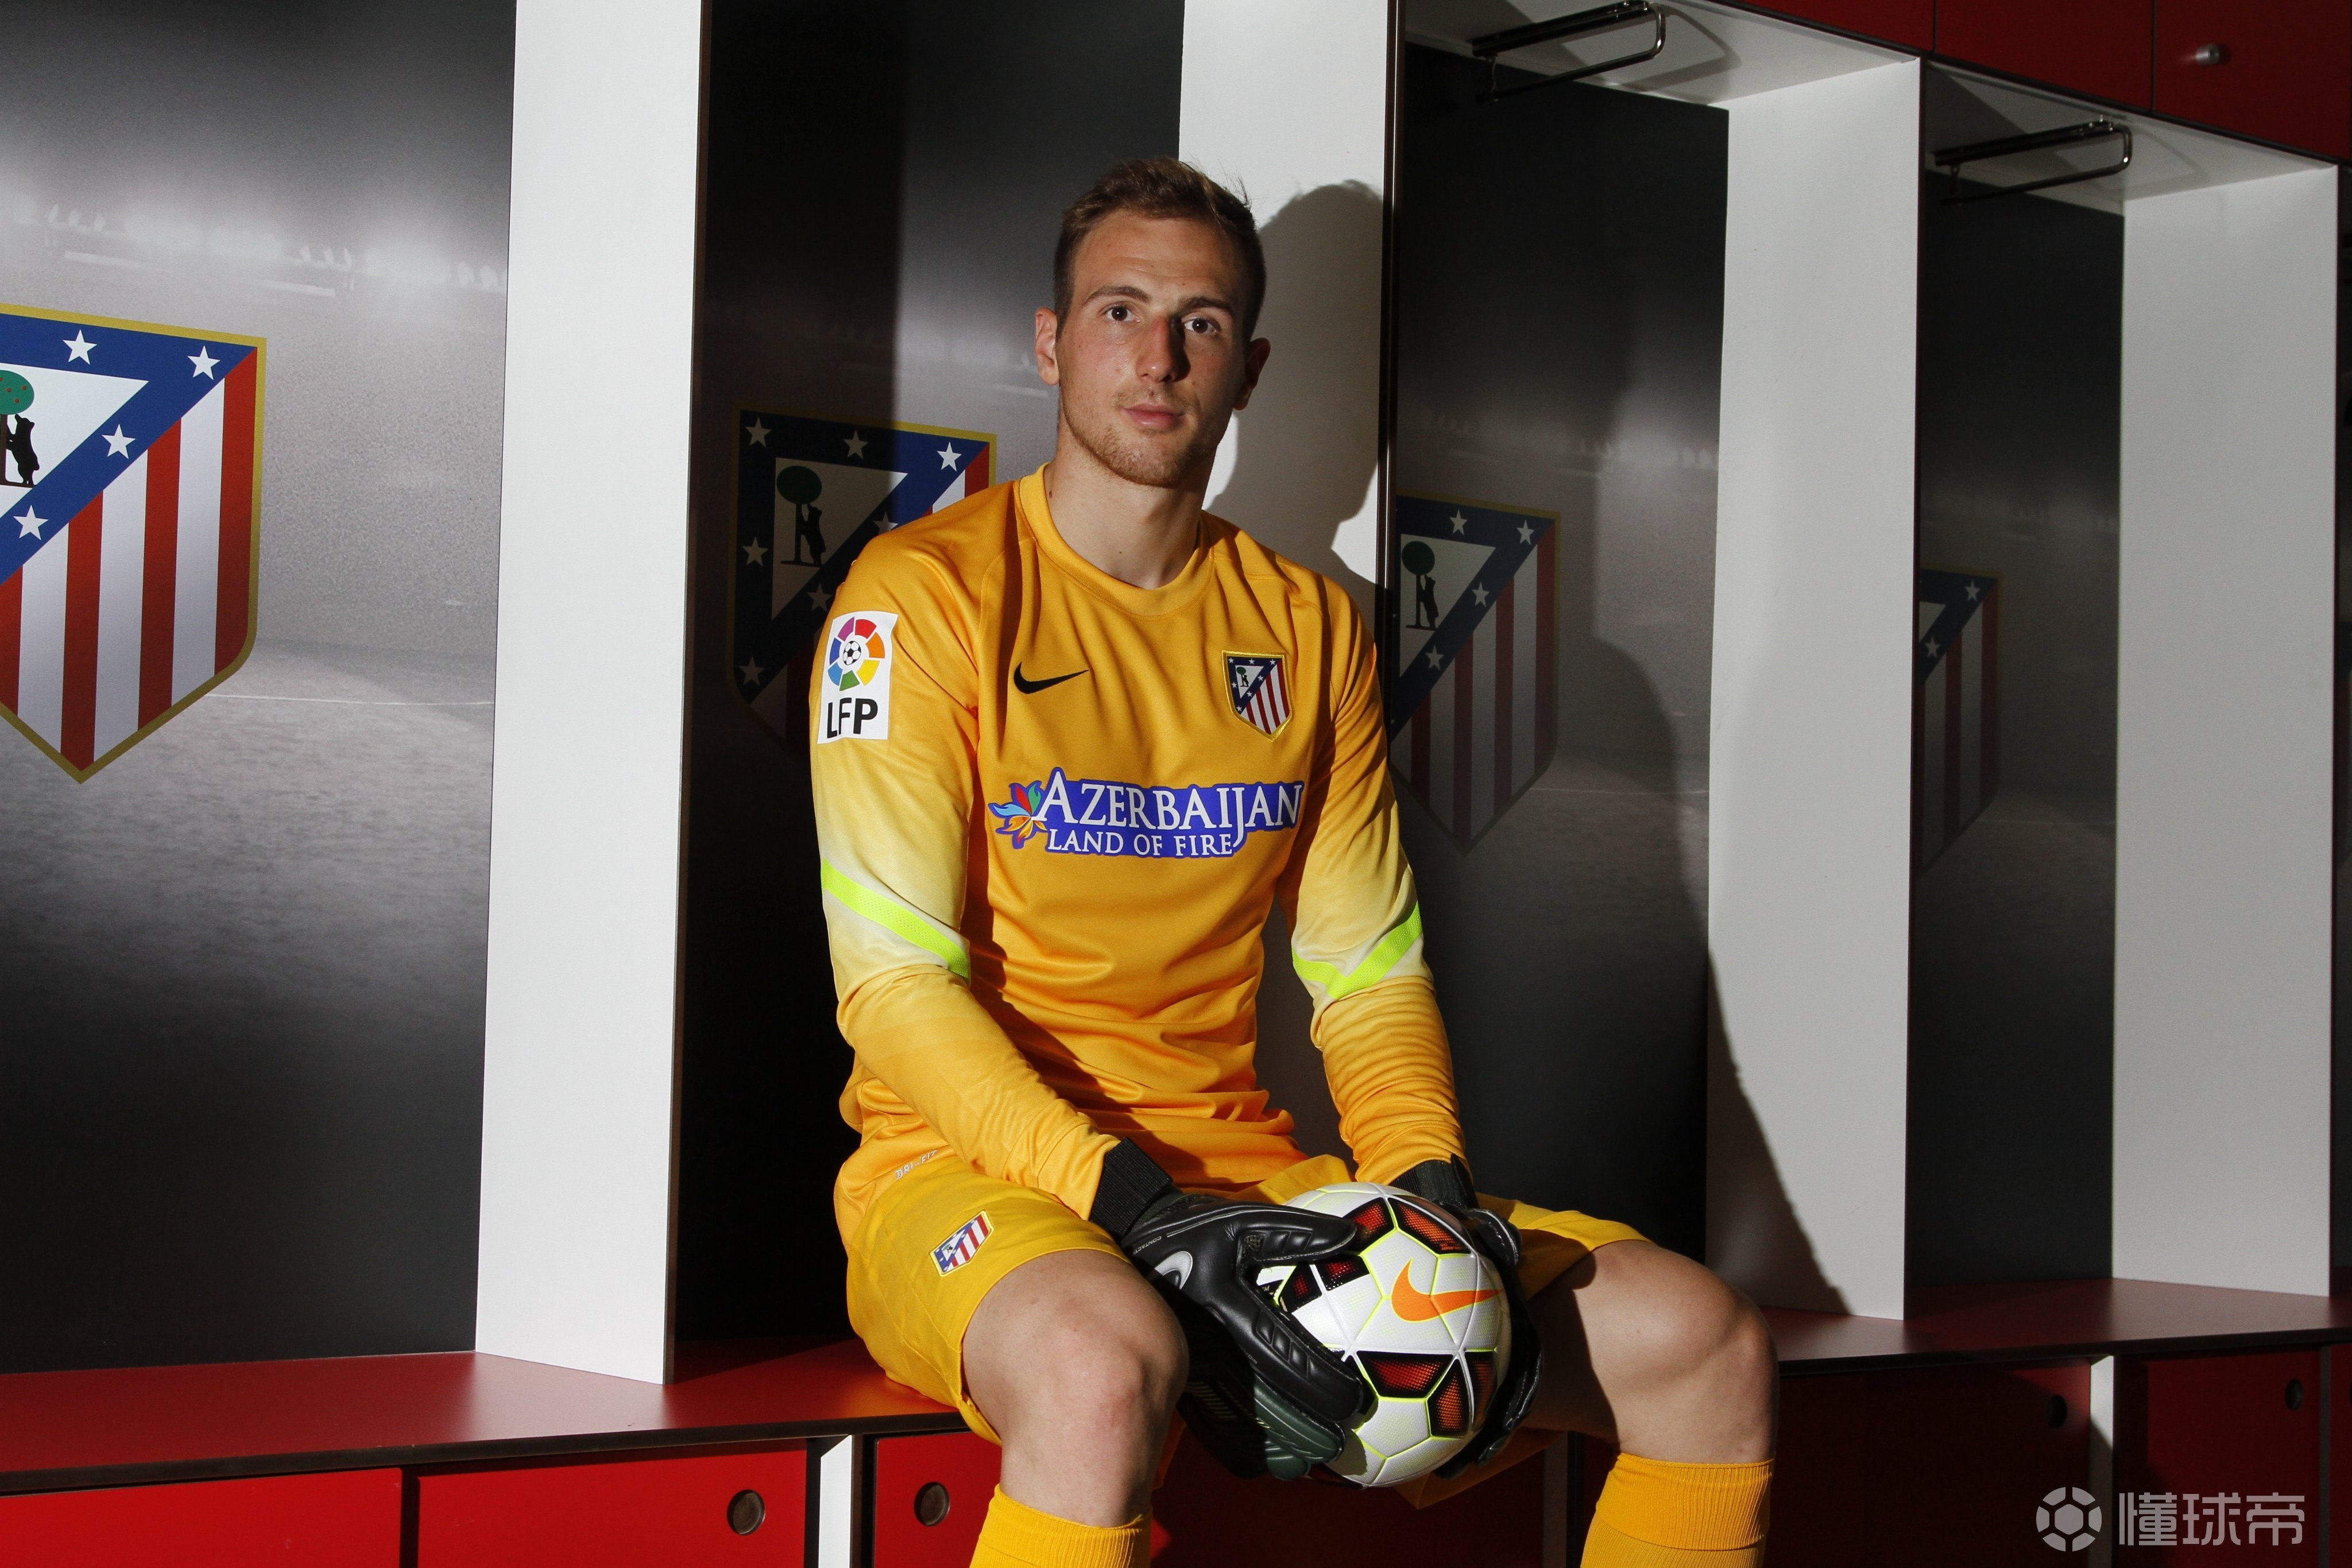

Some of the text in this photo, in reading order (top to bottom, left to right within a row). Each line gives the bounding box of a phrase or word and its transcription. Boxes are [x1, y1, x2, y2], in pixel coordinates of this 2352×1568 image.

[827, 698, 879, 739] LFP
[1031, 771, 1302, 848] AZERBAIJAN
[1047, 828, 1233, 857] LAND OF FIRE
[895, 1149, 937, 1180] DRI-FIT
